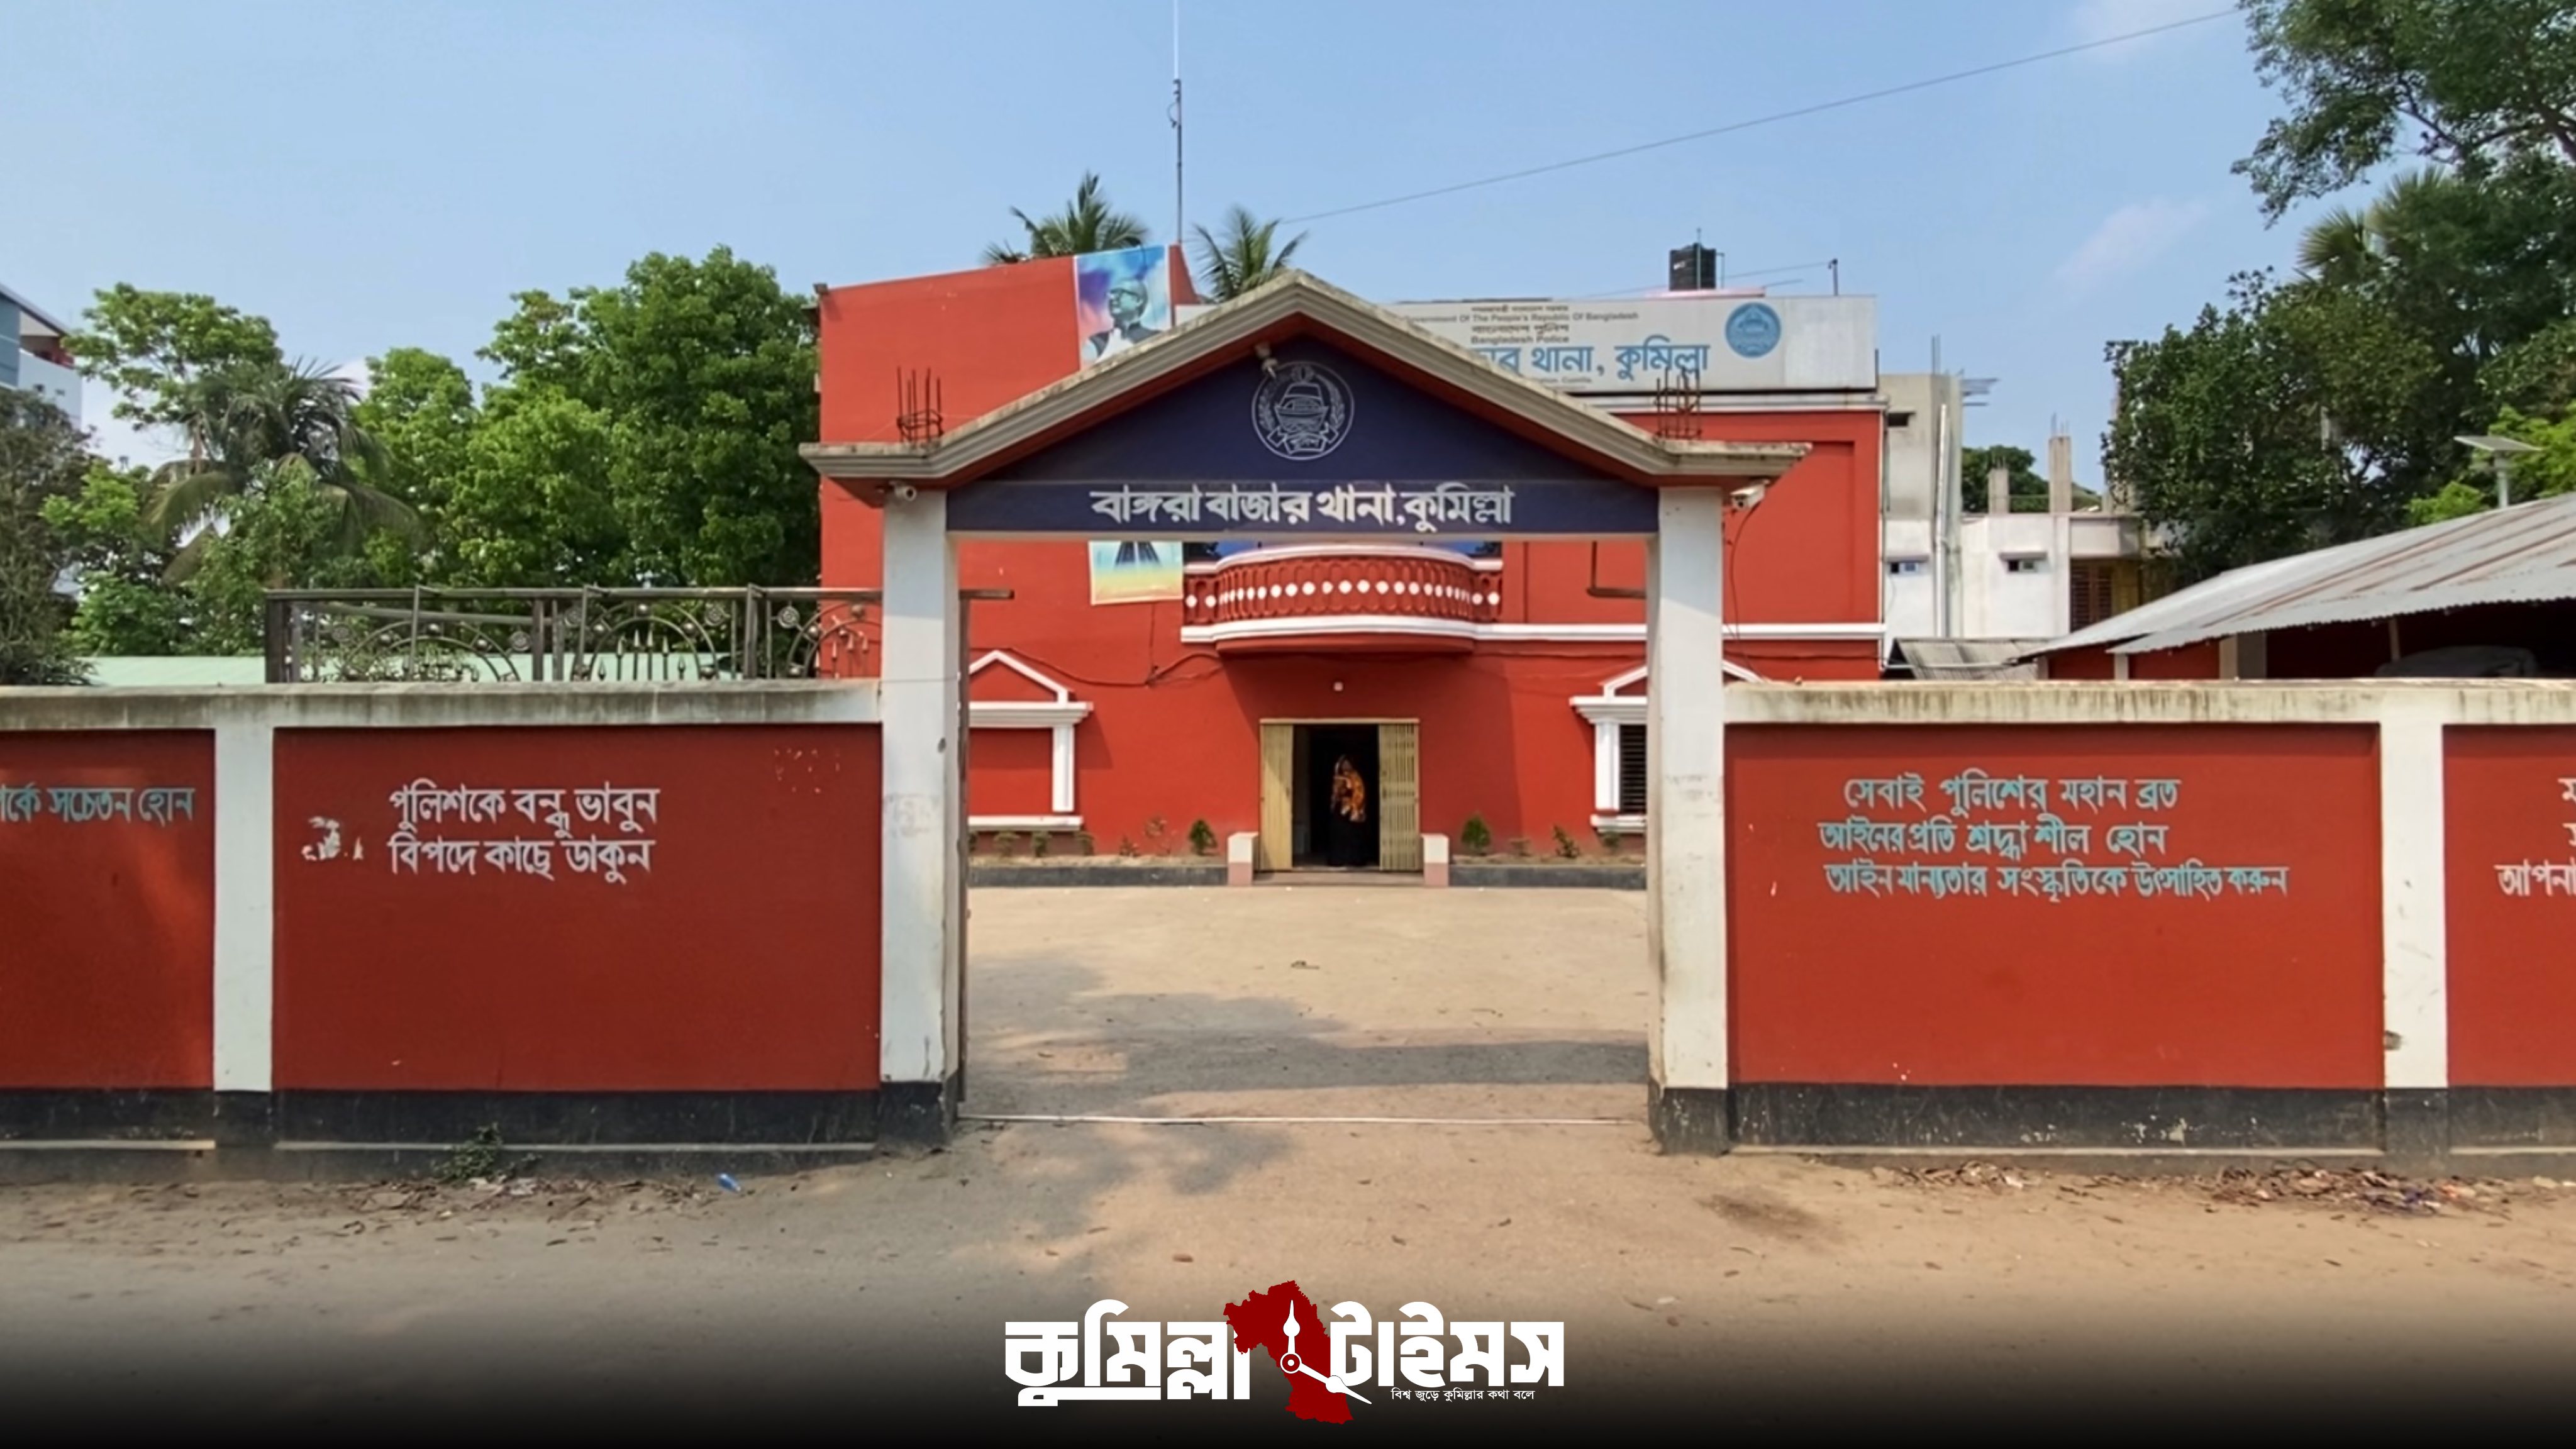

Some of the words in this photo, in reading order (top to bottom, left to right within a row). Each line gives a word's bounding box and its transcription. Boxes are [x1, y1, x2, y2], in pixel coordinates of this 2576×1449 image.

[1531, 347, 1606, 376] থানা,
[1089, 484, 1202, 523] বাঙ্গরা
[1205, 482, 1313, 525] বাজার
[1400, 482, 1516, 533] কুমিল্লা
[47, 788, 135, 823] সচেতন
[138, 787, 196, 828] হোন
[389, 777, 506, 834] পুলিশকে
[511, 789, 573, 839] বন্ধু
[574, 780, 660, 833] ভাবুন
[1843, 771, 1927, 813] সেবাই
[1938, 767, 2049, 819] পুলিশের
[2057, 775, 2128, 814] মহান
[2133, 779, 2182, 811] ব্রত
[386, 831, 480, 875] বিপদে
[483, 835, 555, 881] কাছে
[560, 833, 656, 884] ডাকুন
[1816, 814, 1906, 855] আইনের
[1907, 814, 1958, 855] প্রতি
[1965, 819, 2031, 862] শ্রদ্ধা
[2033, 812, 2092, 855] শীল
[2106, 821, 2169, 859] হোন
[1823, 857, 1893, 898] আইন
[1996, 857, 2129, 903] সংস্কৃতিকে
[2223, 865, 2290, 897] করুন
